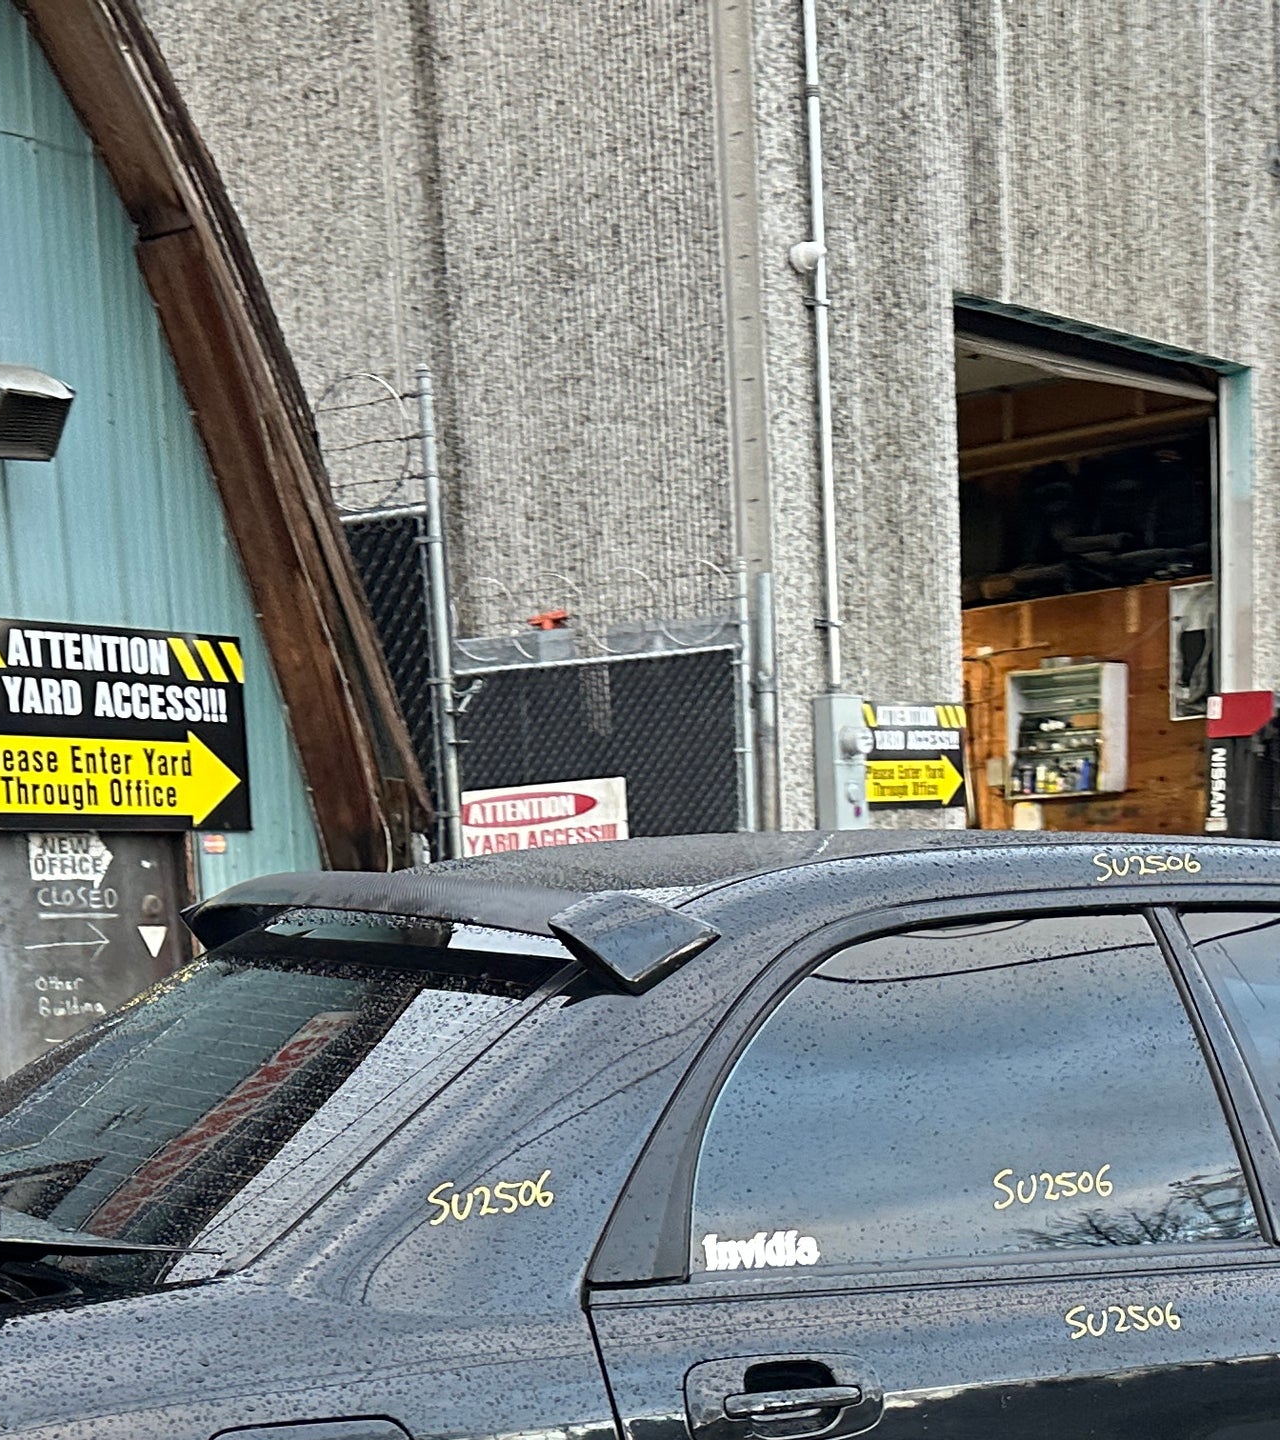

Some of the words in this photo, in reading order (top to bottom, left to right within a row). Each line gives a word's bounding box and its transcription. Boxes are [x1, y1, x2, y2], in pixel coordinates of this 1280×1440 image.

[7, 628, 170, 676] ATTENTION
[1, 675, 83, 716] YARD
[94, 681, 228, 723] ACCESS!!!
[70, 745, 132, 776] Enter
[141, 748, 193, 778] Yard
[0, 776, 99, 810] Through
[110, 778, 177, 808] Office
[1210, 747, 1227, 817] NISSAN
[468, 794, 577, 825] ATTENTION
[43, 836, 89, 854] NEW
[467, 832, 520, 856] YARD
[34, 854, 104, 875] OFFICE
[1093, 852, 1202, 882] SU2506
[36, 887, 118, 909] CLOSED
[427, 1169, 555, 1226] SU2506
[993, 1164, 1113, 1210] SU2506
[1065, 1302, 1181, 1339] SU2506
